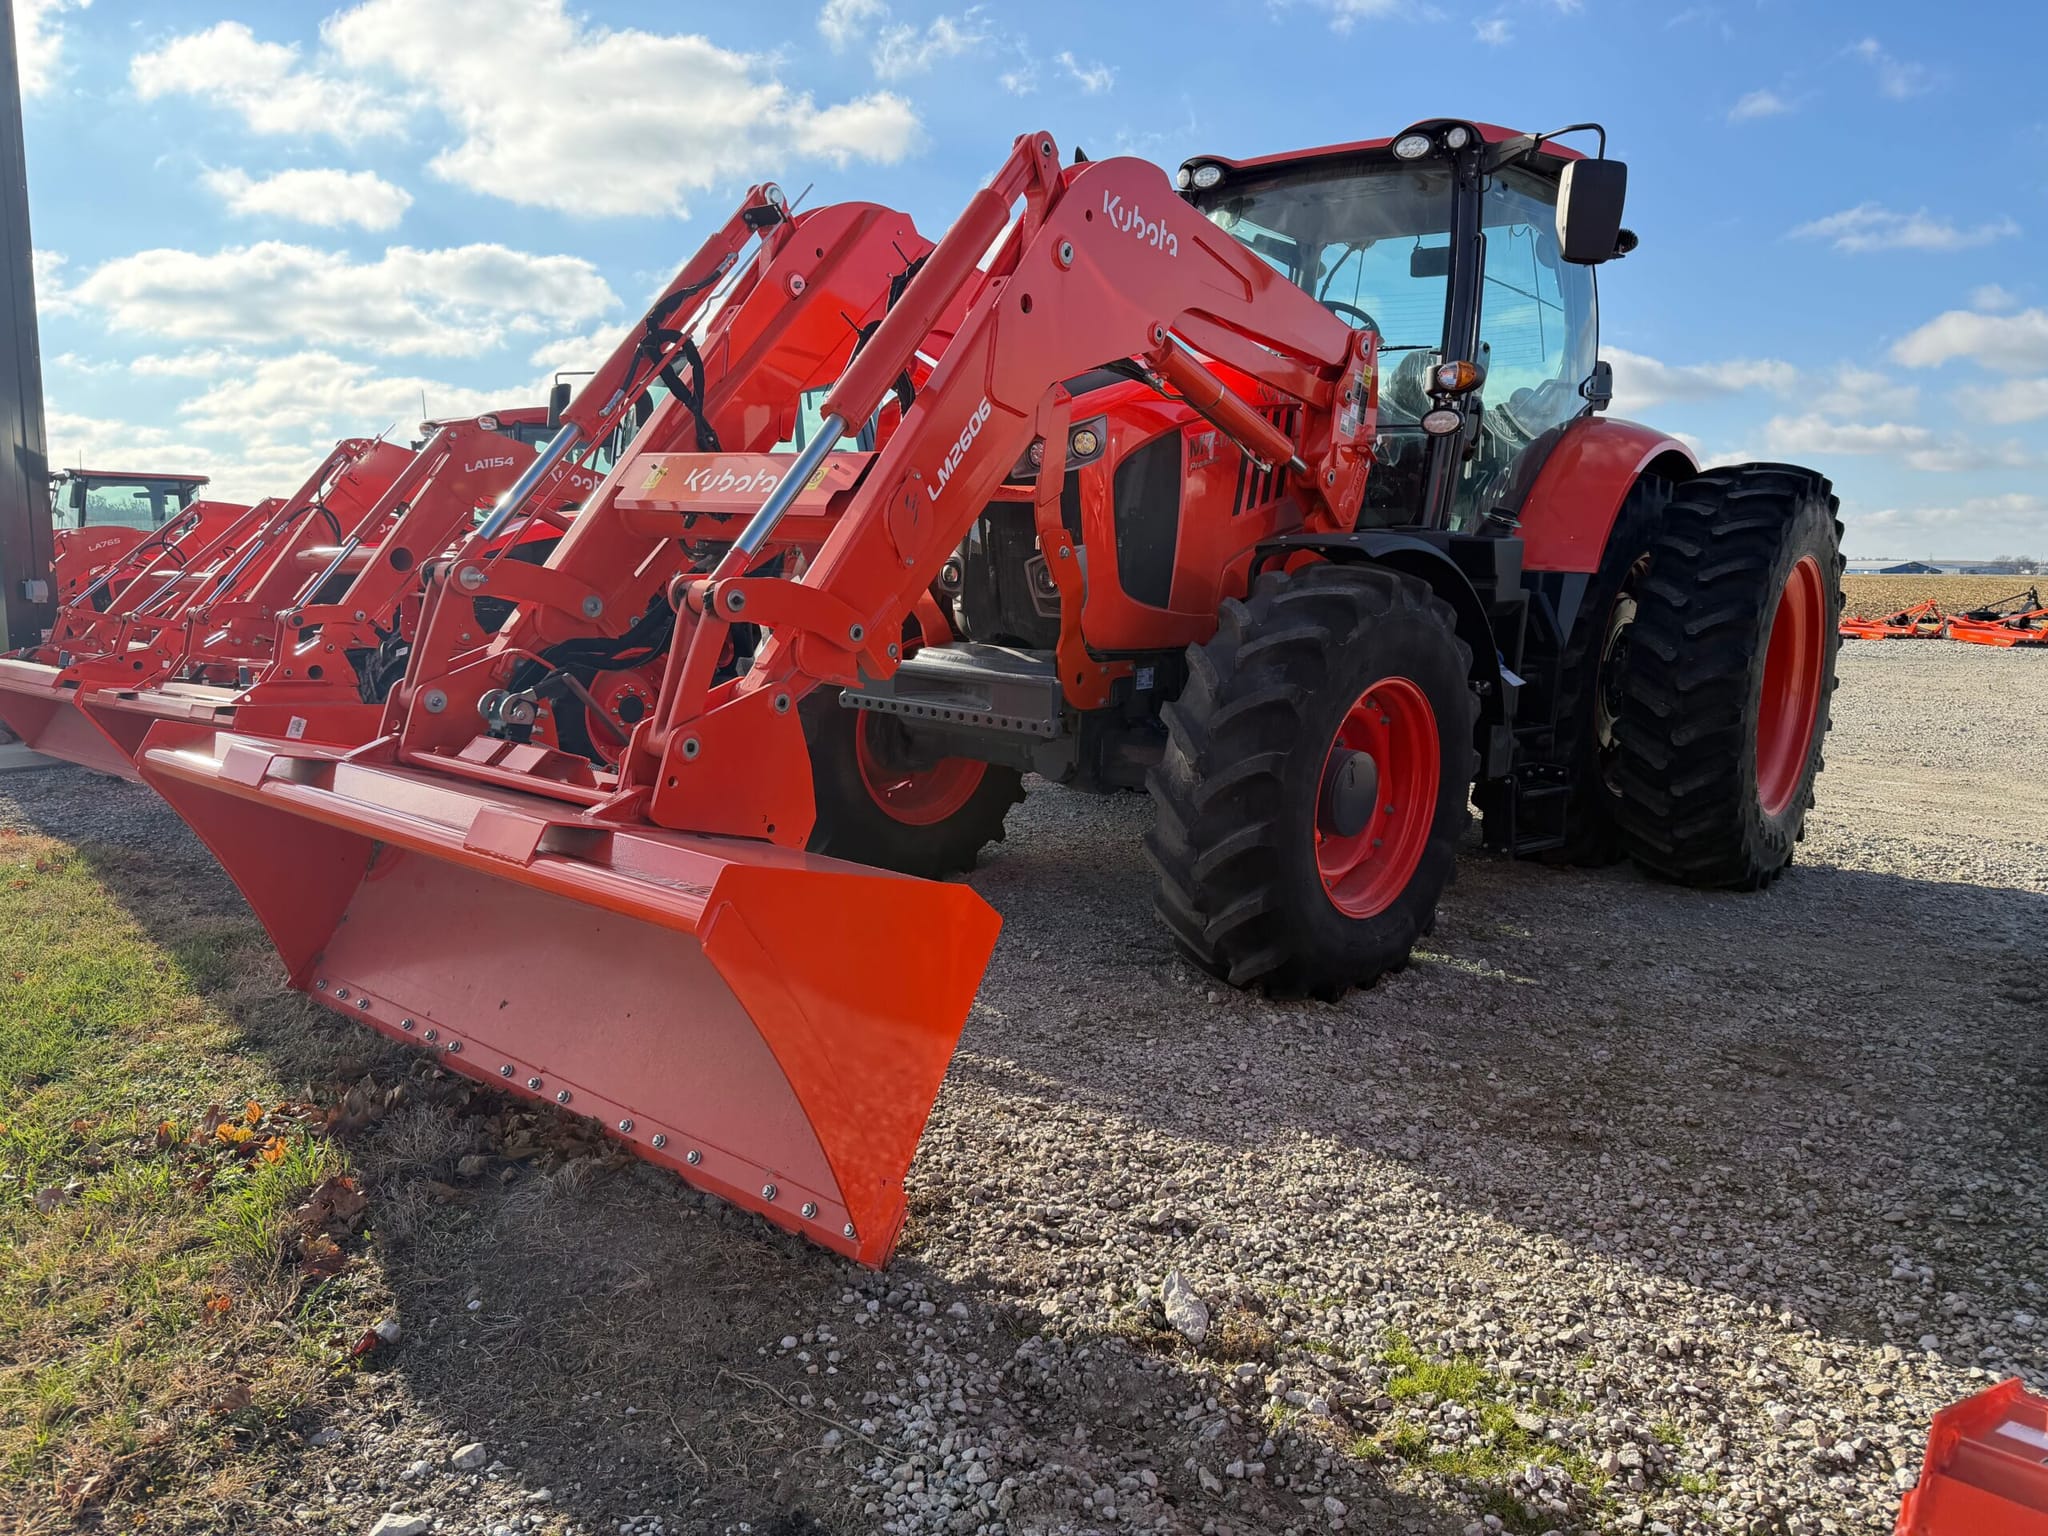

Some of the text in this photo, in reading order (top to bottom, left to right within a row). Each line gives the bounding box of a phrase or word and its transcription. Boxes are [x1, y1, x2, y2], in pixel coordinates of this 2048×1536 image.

[1103, 189, 1178, 257] Kubota
[464, 456, 514, 473] LA1154
[927, 395, 992, 501] LM2606
[684, 467, 778, 493] Kubota
